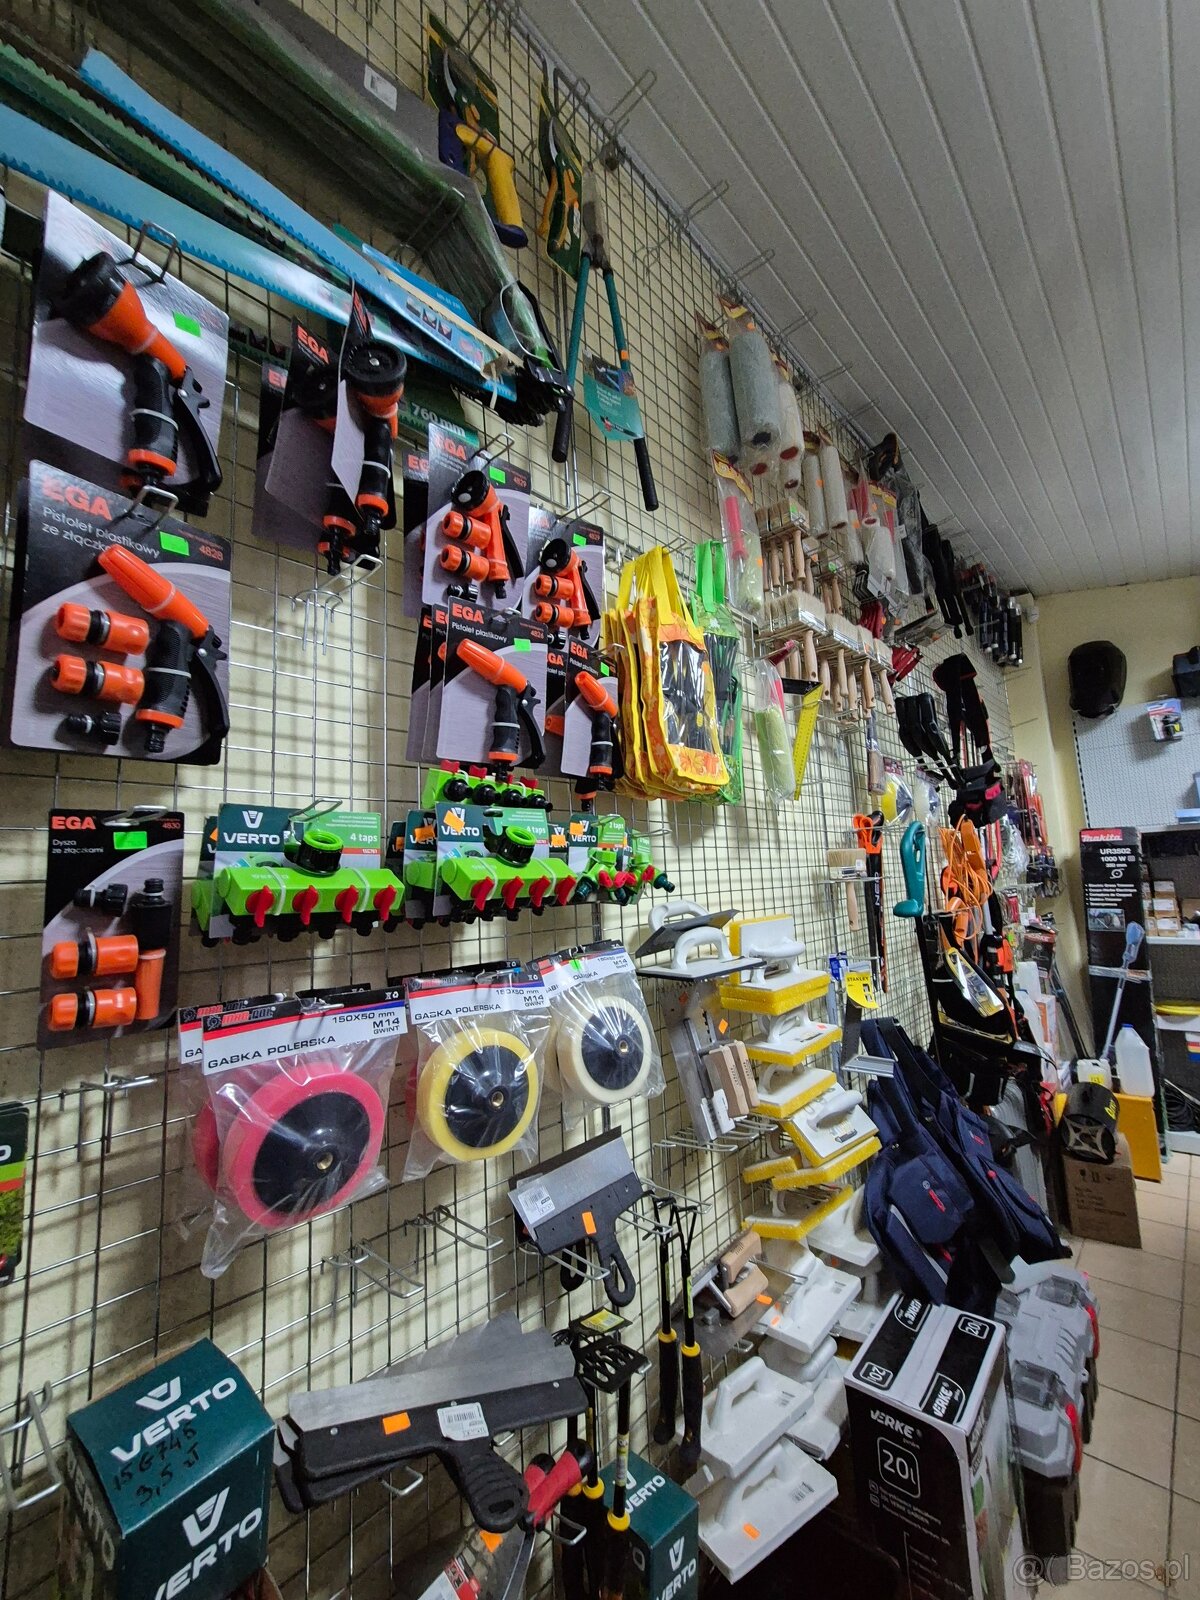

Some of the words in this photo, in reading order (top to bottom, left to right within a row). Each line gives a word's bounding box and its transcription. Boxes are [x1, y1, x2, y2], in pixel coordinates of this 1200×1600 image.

[297, 325, 330, 365] EGA
[411, 402, 438, 423] 760
[439, 419, 466, 438] mm
[408, 454, 429, 475] EG
[42, 475, 112, 521] EGA
[42, 506, 94, 534] Pistolet
[95, 527, 160, 560] plastikowy
[42, 521, 60, 536] ze
[62, 528, 110, 554] złączk
[452, 602, 484, 625] EGA
[452, 622, 475, 635] Pistolet
[475, 629, 508, 644] plastikowy
[570, 641, 588, 660] EGA
[546, 652, 564, 667] GA
[51, 815, 96, 830] EGA
[441, 824, 480, 837] VERTO
[532, 825, 546, 836] taps
[52, 839, 76, 847] Dysza
[223, 831, 281, 845] VERTO
[350, 833, 357, 842] 4
[358, 833, 378, 844] taps
[571, 834, 597, 843] VERTO
[523, 994, 544, 1003] M14
[455, 1003, 501, 1014] POLERSKA
[332, 1012, 376, 1025] 150X50
[378, 1010, 396, 1018] mm
[372, 1017, 400, 1029] M14
[373, 1026, 400, 1035] GWINT
[267, 1035, 336, 1056] POLERSKA
[110, 1376, 238, 1463] VERTO
[870, 1409, 916, 1440] VERKE
[624, 1474, 667, 1514] VERTO
